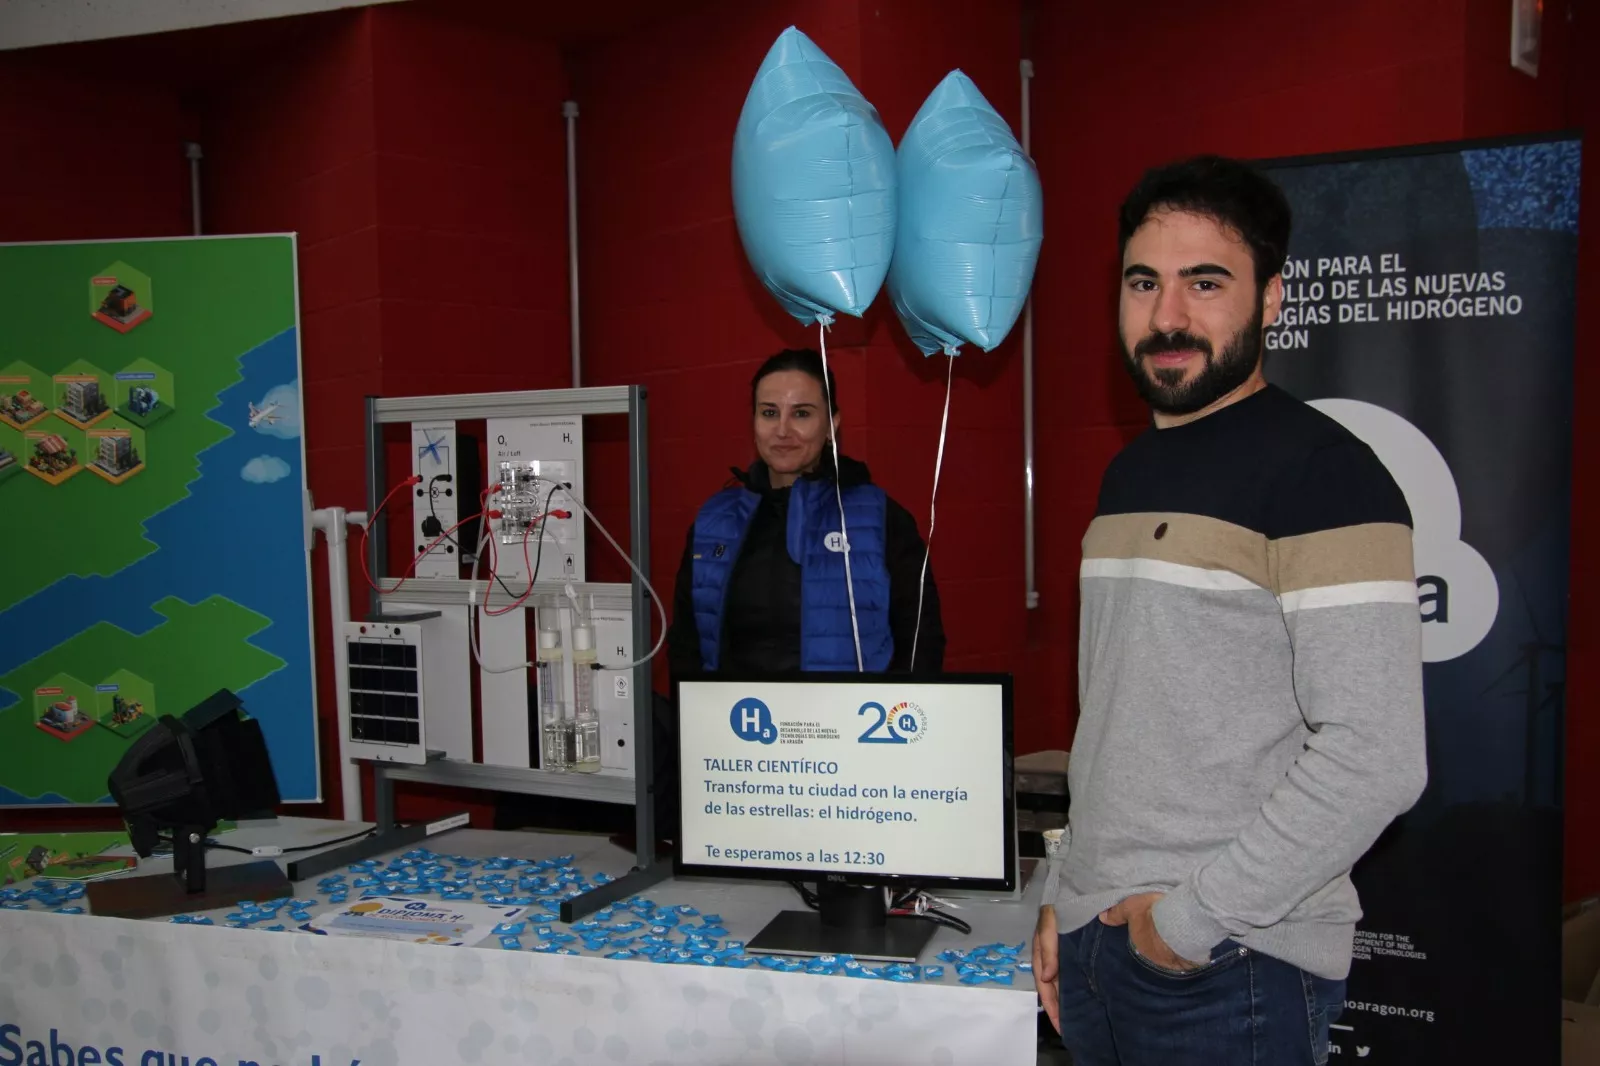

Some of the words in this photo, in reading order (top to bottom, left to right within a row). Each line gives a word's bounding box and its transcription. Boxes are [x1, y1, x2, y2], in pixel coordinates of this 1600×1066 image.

[1317, 255, 1373, 277] PARA
[1380, 253, 1406, 273] EL
[1331, 279, 1360, 300] DE
[1367, 276, 1407, 298] LAS
[1414, 270, 1506, 296] NUEVAS
[1338, 303, 1379, 323] DEL
[1386, 292, 1523, 321] HIDRÓGENO
[703, 758, 754, 774] TALLER
[757, 757, 839, 775] CIENTÍFICO
[704, 780, 785, 797] Transforma
[788, 783, 804, 797] tu
[808, 781, 858, 798] ciudad
[861, 786, 889, 799] con
[893, 784, 906, 799] la
[910, 785, 968, 804] energía
[704, 802, 722, 816] de
[726, 802, 746, 817] las
[749, 804, 815, 819] estrellas:
[819, 805, 832, 820] el
[836, 806, 918, 825] hidrógeno.
[705, 844, 721, 858] Te
[724, 847, 803, 863] esperamos
[806, 851, 816, 862] a
[819, 848, 839, 864] las
[844, 850, 886, 867] 12:30
[1379, 933, 1394, 941] FOR
[1395, 934, 1411, 943] THE
[1397, 942, 1415, 951] NEW
[1373, 947, 1427, 960] TECHNOLOGIES
[0, 1023, 124, 1066] Sabes
